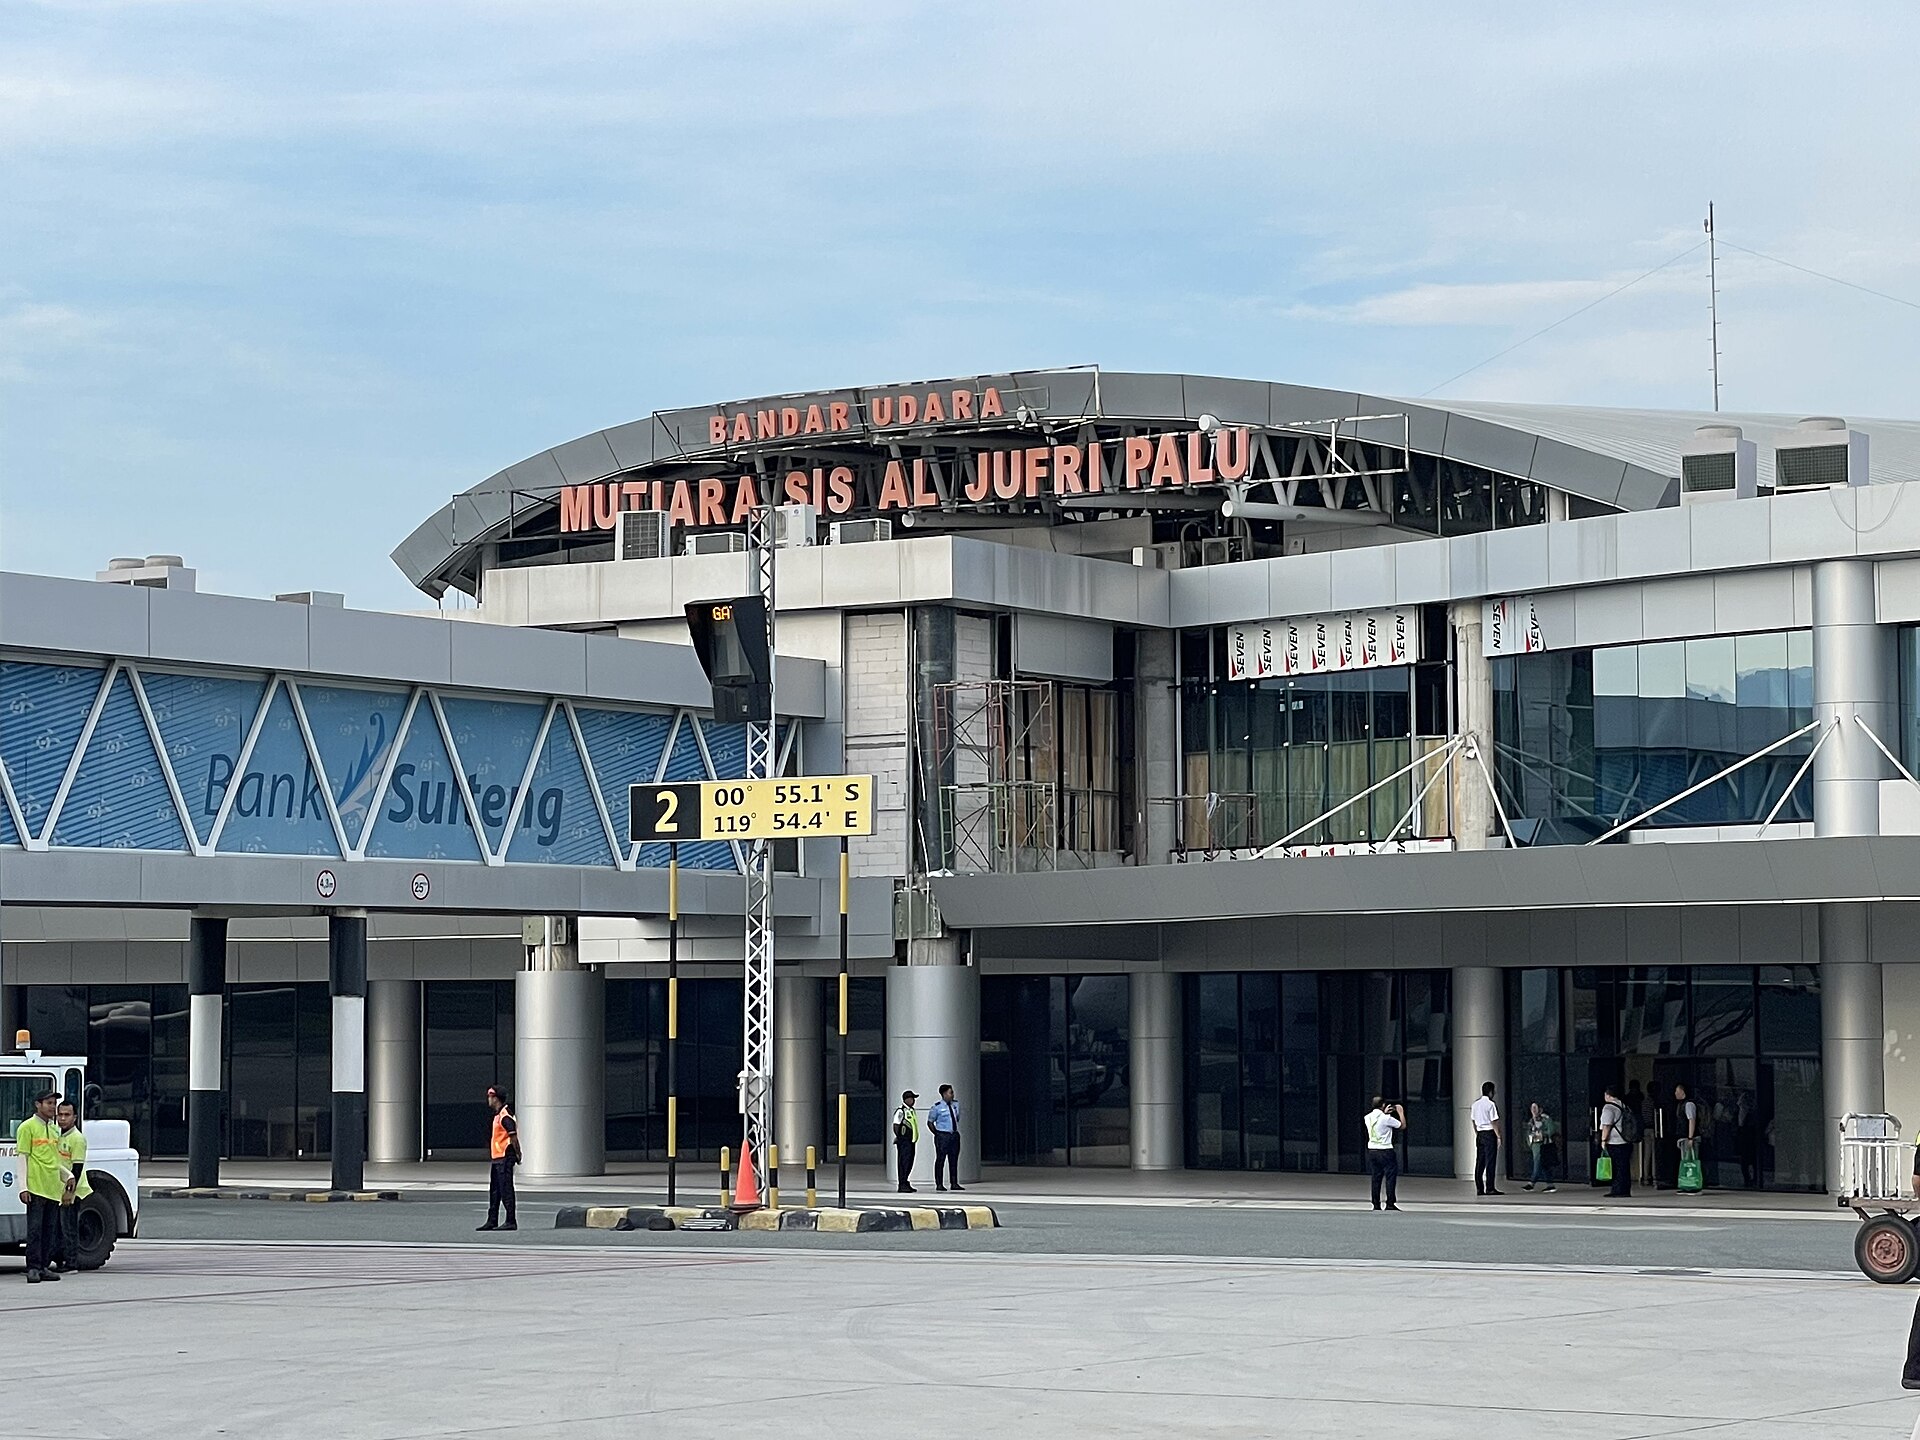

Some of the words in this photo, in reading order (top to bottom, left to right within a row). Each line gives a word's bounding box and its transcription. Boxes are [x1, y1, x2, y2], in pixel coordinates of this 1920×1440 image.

[709, 401, 850, 445] BANDAR
[871, 387, 1005, 427] UDARA
[560, 476, 760, 533] MUTIARA
[784, 466, 856, 516] SIS
[877, 458, 939, 511] AL
[964, 441, 1102, 502] JUFRI
[1125, 428, 1251, 489] PALU
[712, 605, 732, 621] GA
[1492, 603, 1500, 649] SEVEN
[1530, 603, 1539, 649] SEVE
[1236, 632, 1245, 674] SEVEN
[1263, 629, 1272, 672] SEVEN
[1289, 626, 1298, 669] SEVEN
[1316, 623, 1326, 666] SEVEN
[1368, 618, 1376, 662] SEVEN
[1396, 614, 1406, 658] SEVEN
[204, 753, 323, 821] Bank
[387, 763, 564, 847] Sulteng
[654, 790, 679, 833] 2
[714, 785, 753, 806] 00°
[774, 784, 831, 804] 55.1'
[845, 783, 859, 801] S
[714, 812, 756, 833] 119°
[773, 811, 830, 830] 54.4'
[845, 811, 858, 828] E
